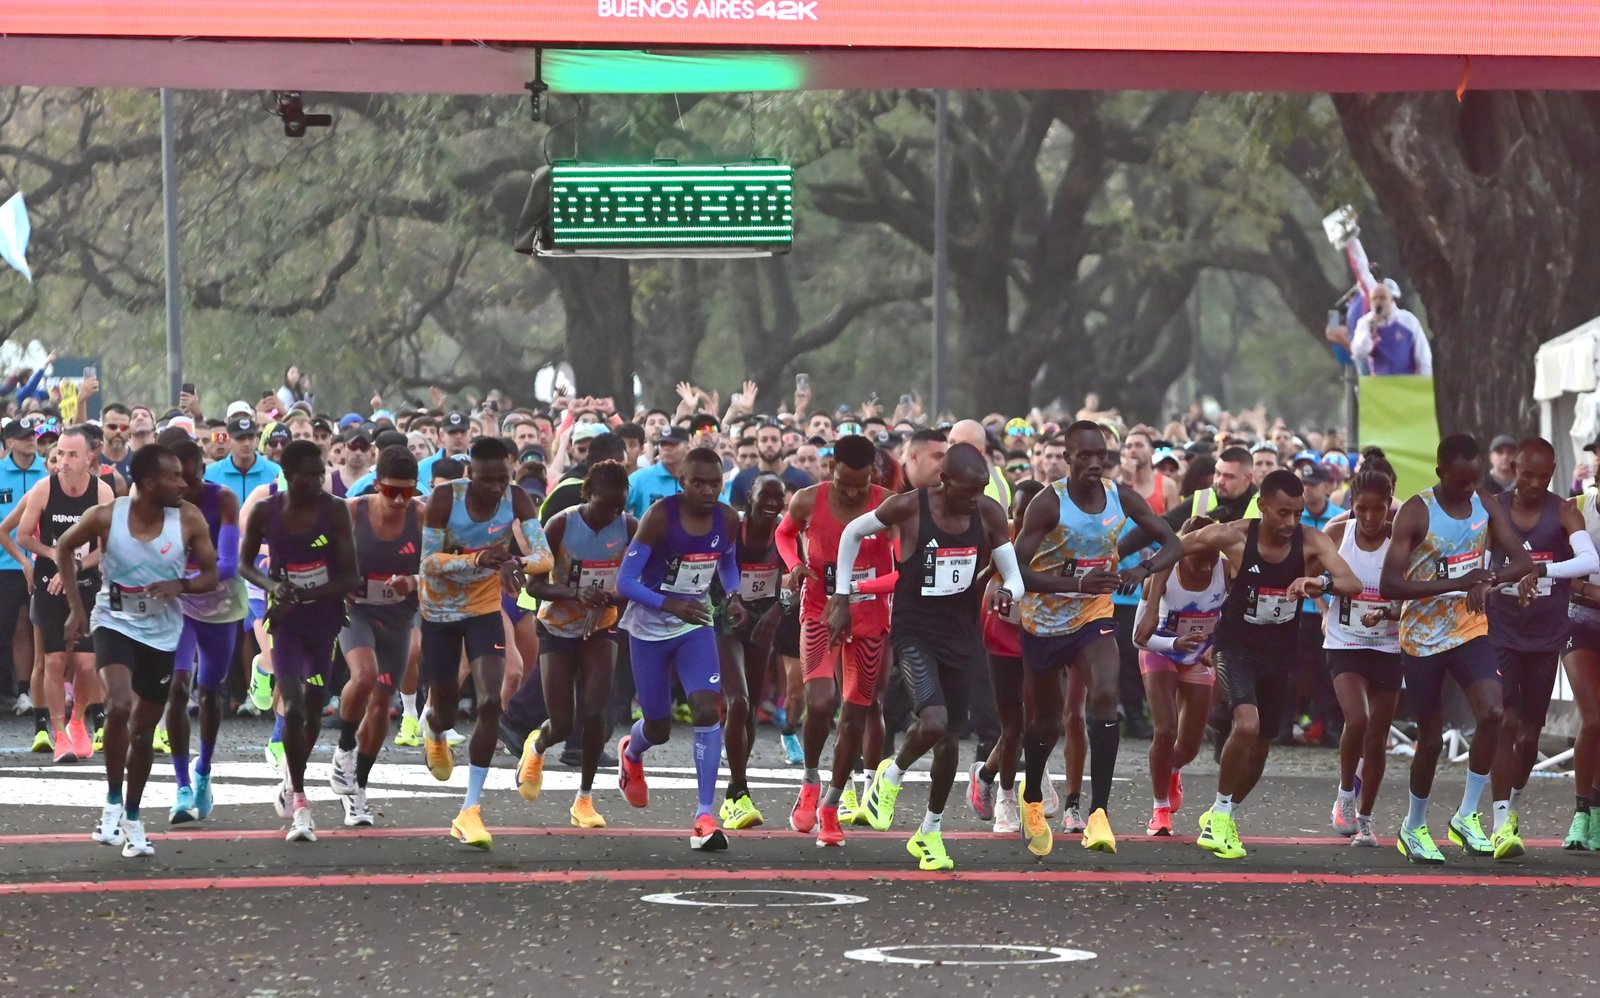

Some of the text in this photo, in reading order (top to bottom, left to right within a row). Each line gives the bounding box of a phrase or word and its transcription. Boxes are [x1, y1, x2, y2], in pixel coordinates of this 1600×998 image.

[597, 0, 689, 19] BUENOS
[691, 573, 700, 585] 4
[952, 569, 960, 584] 6
[751, 581, 766, 593] 52
[382, 588, 394, 599] 15
[138, 601, 147, 613] 9
[1273, 606, 1281, 618] 3
